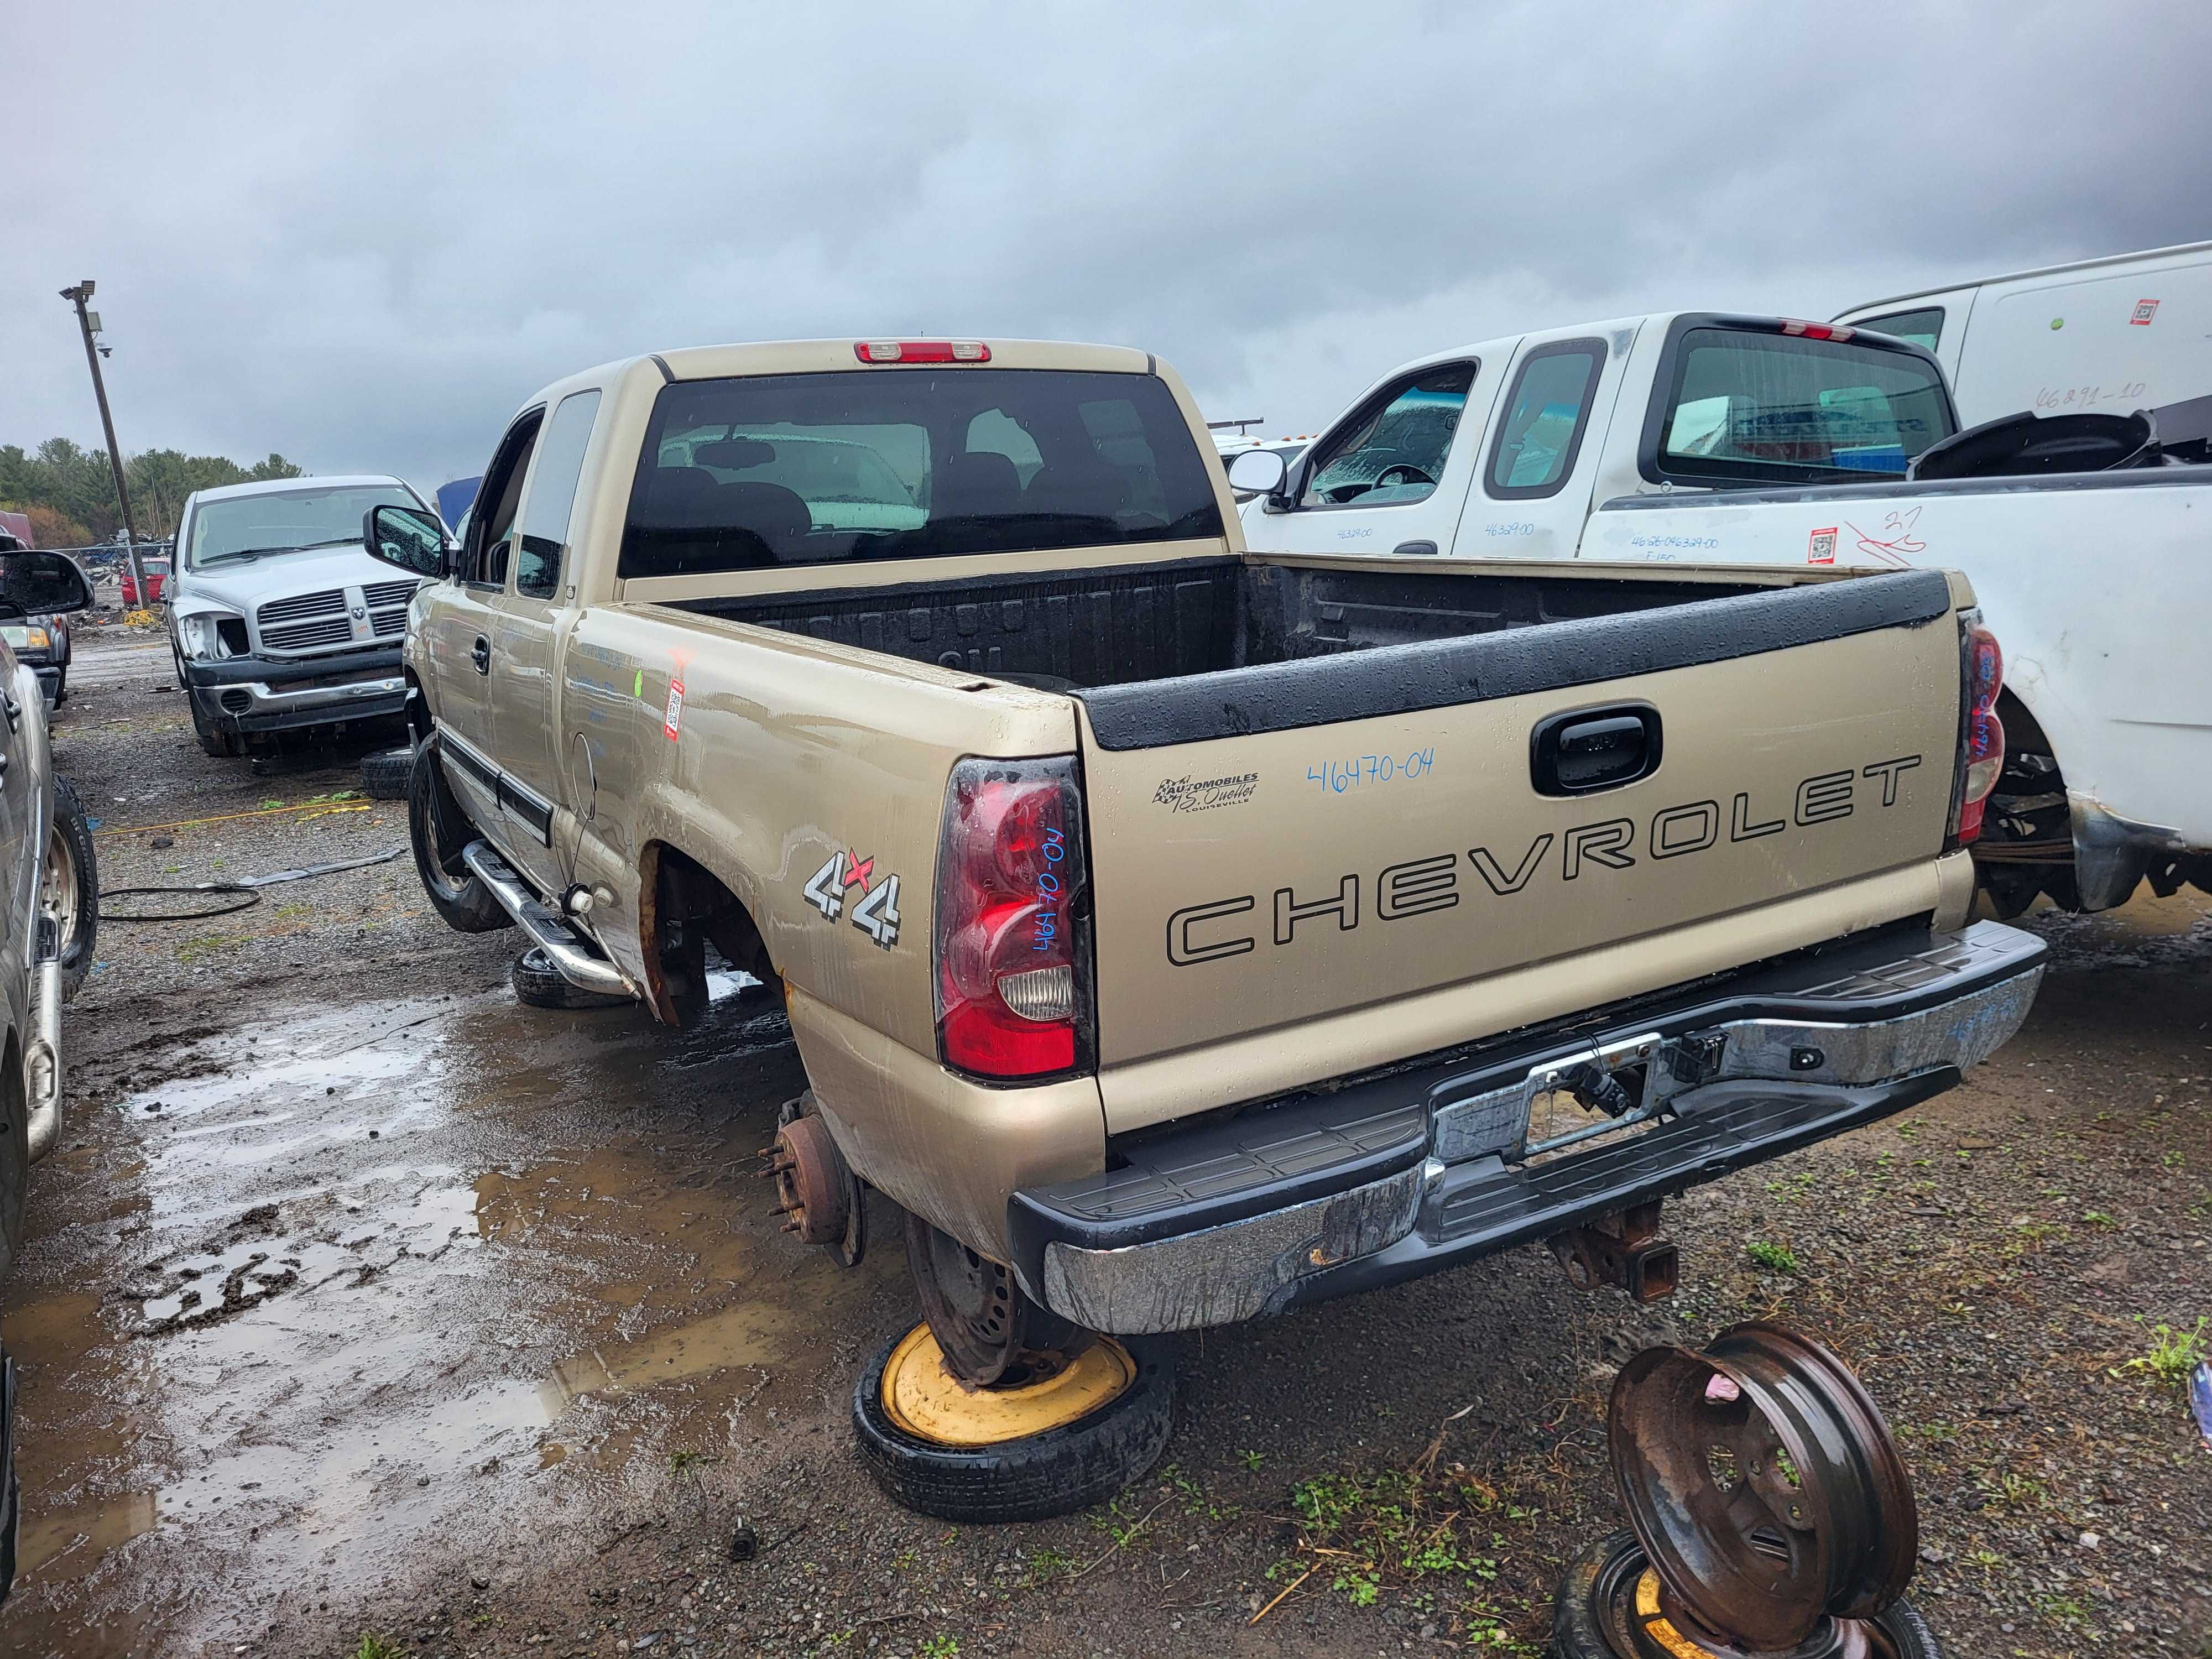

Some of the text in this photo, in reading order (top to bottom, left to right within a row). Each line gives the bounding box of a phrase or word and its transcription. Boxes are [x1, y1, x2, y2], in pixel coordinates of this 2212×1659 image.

[1166, 772, 1259, 795] AUTOMOBILES
[1307, 747, 1434, 793] 46470-04
[1185, 798, 1249, 813] LOUISEVILLE
[1204, 783, 1257, 805] Ouellet
[1166, 754, 1922, 967] CHEVROLET
[1032, 827, 1065, 951] 46470-04
